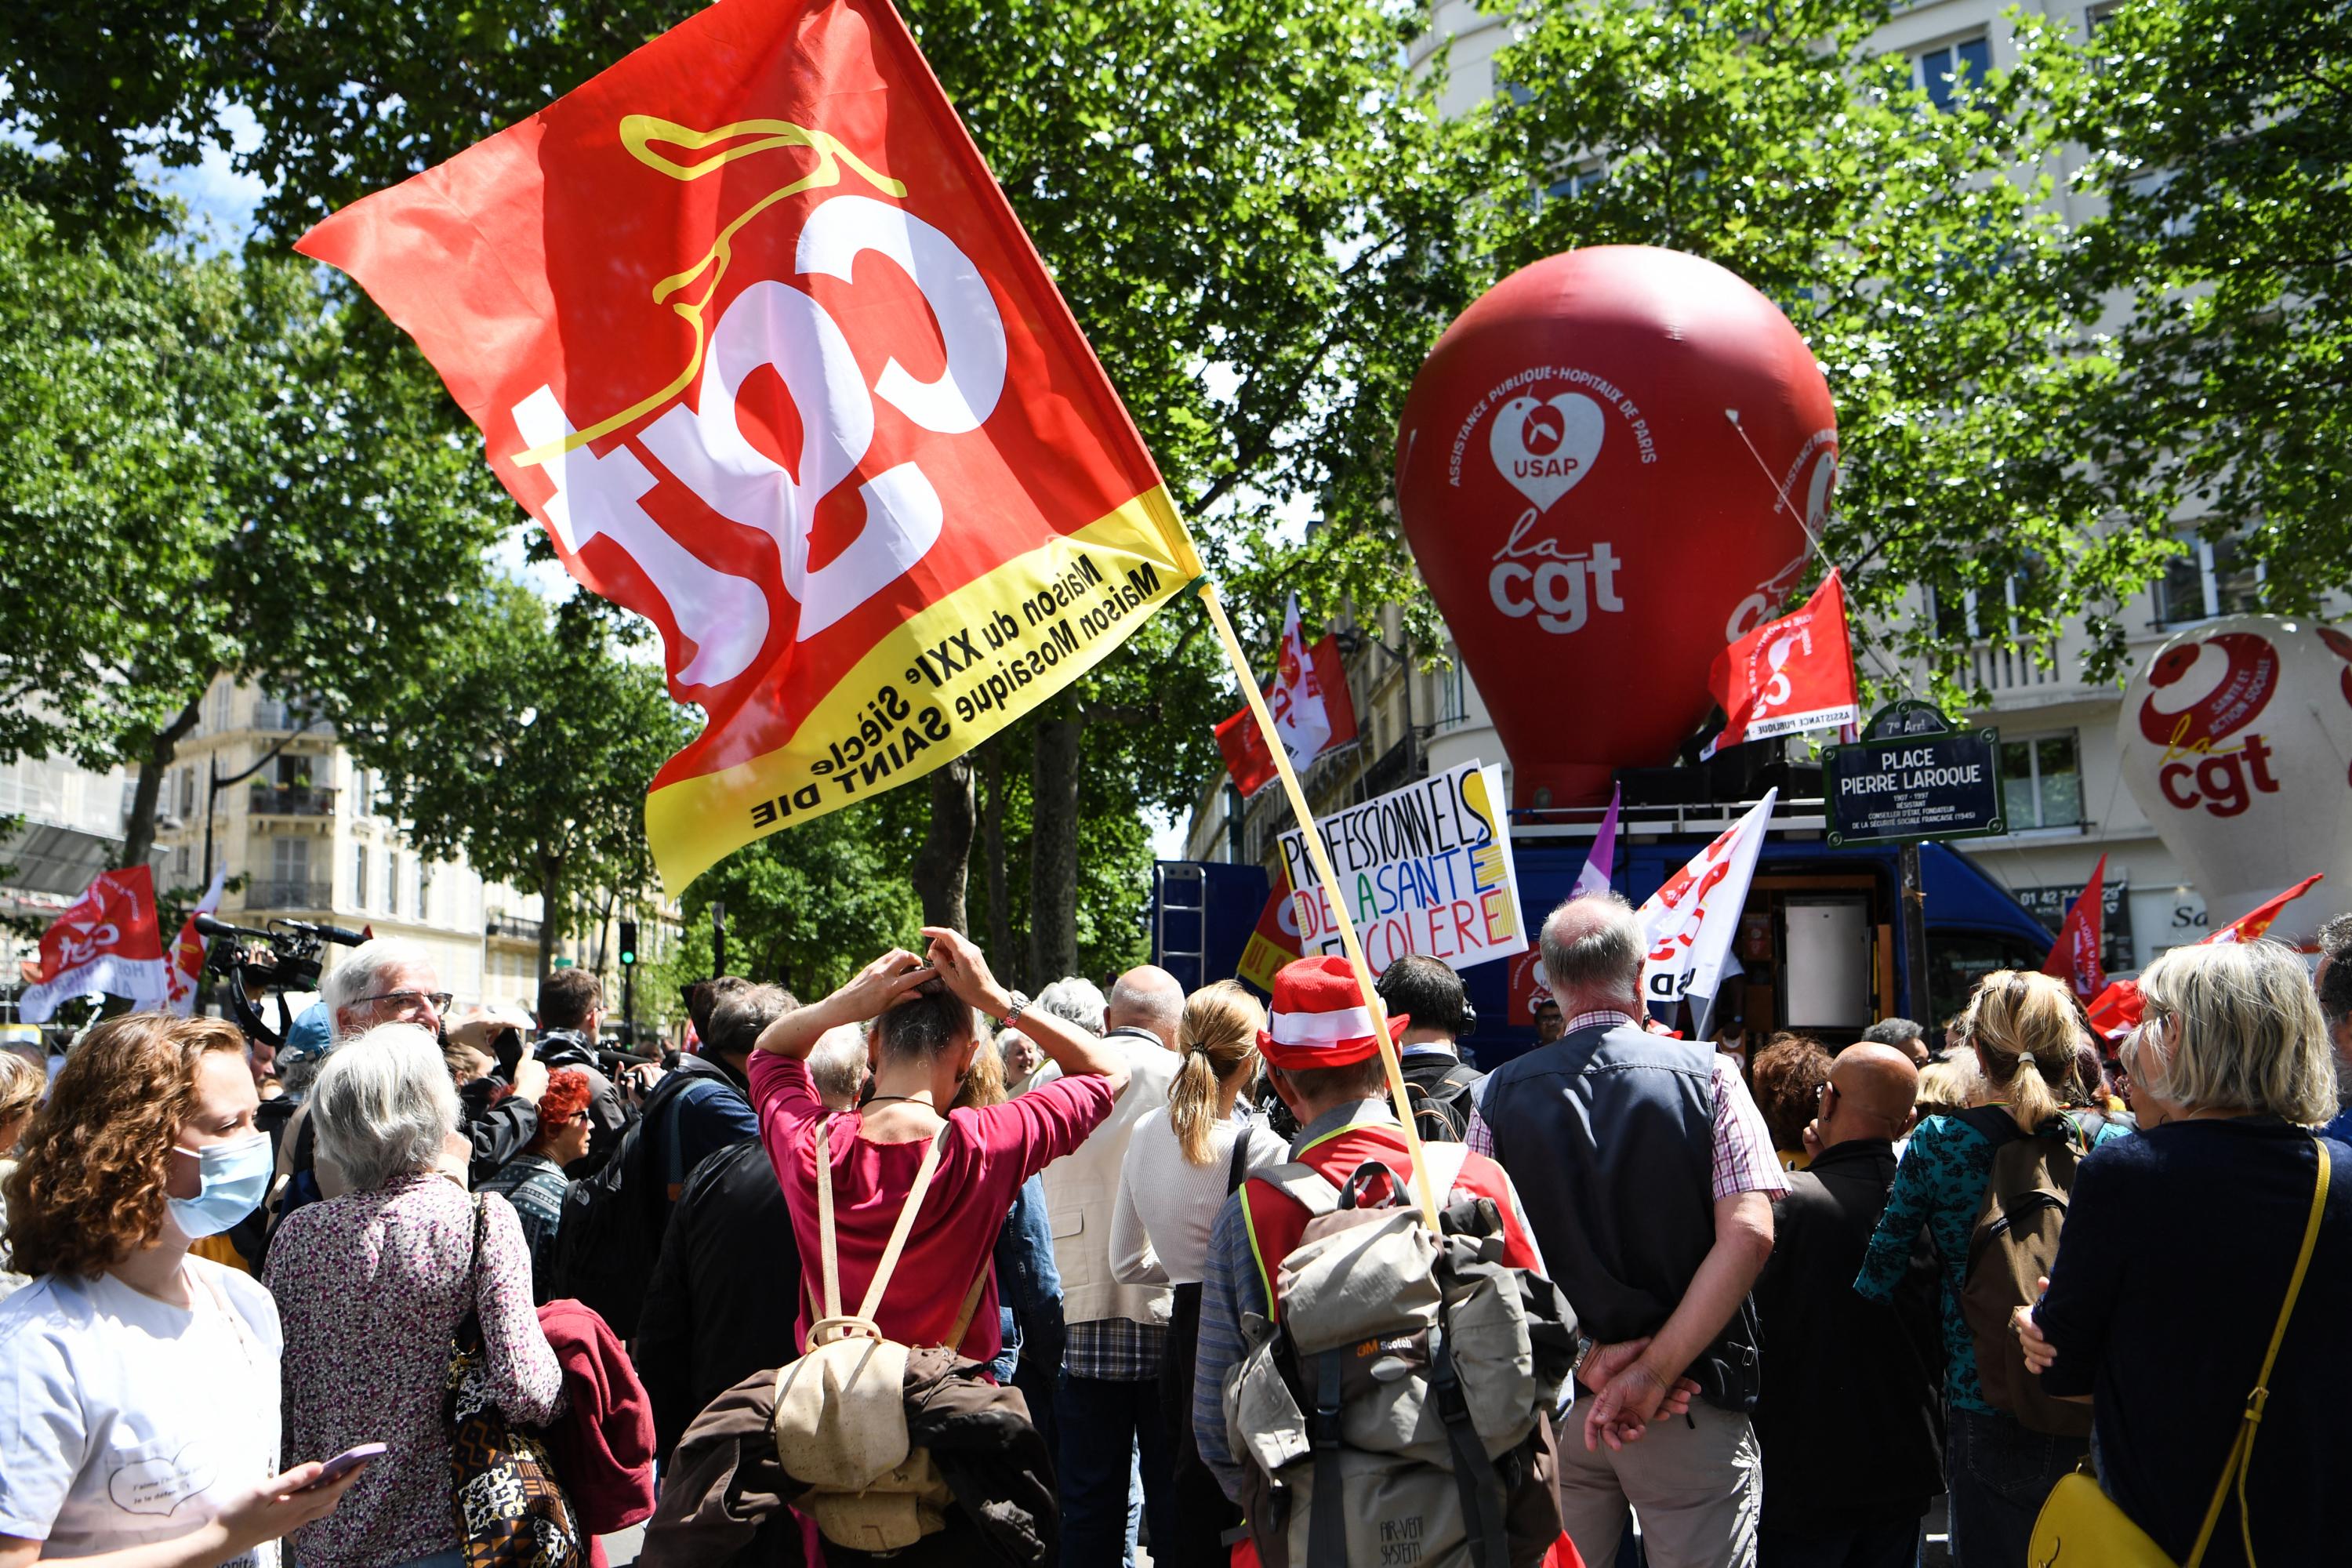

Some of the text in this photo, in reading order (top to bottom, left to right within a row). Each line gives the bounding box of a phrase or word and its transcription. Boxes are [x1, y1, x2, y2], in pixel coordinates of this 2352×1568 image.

[1449, 399, 1489, 487] ASSISTANCE
[1618, 399, 1639, 419] DE
[1632, 419, 1658, 464] PARIS
[1513, 458, 1579, 479] USAP
[1492, 507, 1587, 561] la
[1489, 543, 1624, 634] cgt
[2208, 701, 2249, 735] ACTION
[2158, 713, 2268, 767] la
[1882, 748, 1935, 771] PLACE
[1841, 764, 1982, 796] PIERRE LAROQUE
[2159, 734, 2281, 818] cgt
[1893, 793, 1907, 802] 1907
[1914, 791, 1929, 800] 1997
[1896, 800, 1926, 809] RÉSISTANT
[1868, 809, 1901, 820] CONSEILLER
[1922, 805, 1955, 815] FONDATEUR
[1869, 818, 1896, 829] SÉCURITÉ
[1896, 816, 1921, 826] SOCIALE
[1922, 814, 1954, 825] FRANÇAISE
[1955, 811, 1976, 821] (1945)
[1377, 826, 1497, 915] SANTÉ
[2020, 892, 2037, 907] 01
[2041, 891, 2058, 905] 42
[1365, 888, 1513, 978] COLÈRE
[1380, 1336, 1413, 1351] Scotch
[1381, 1541, 1422, 1566] SYSTEM
